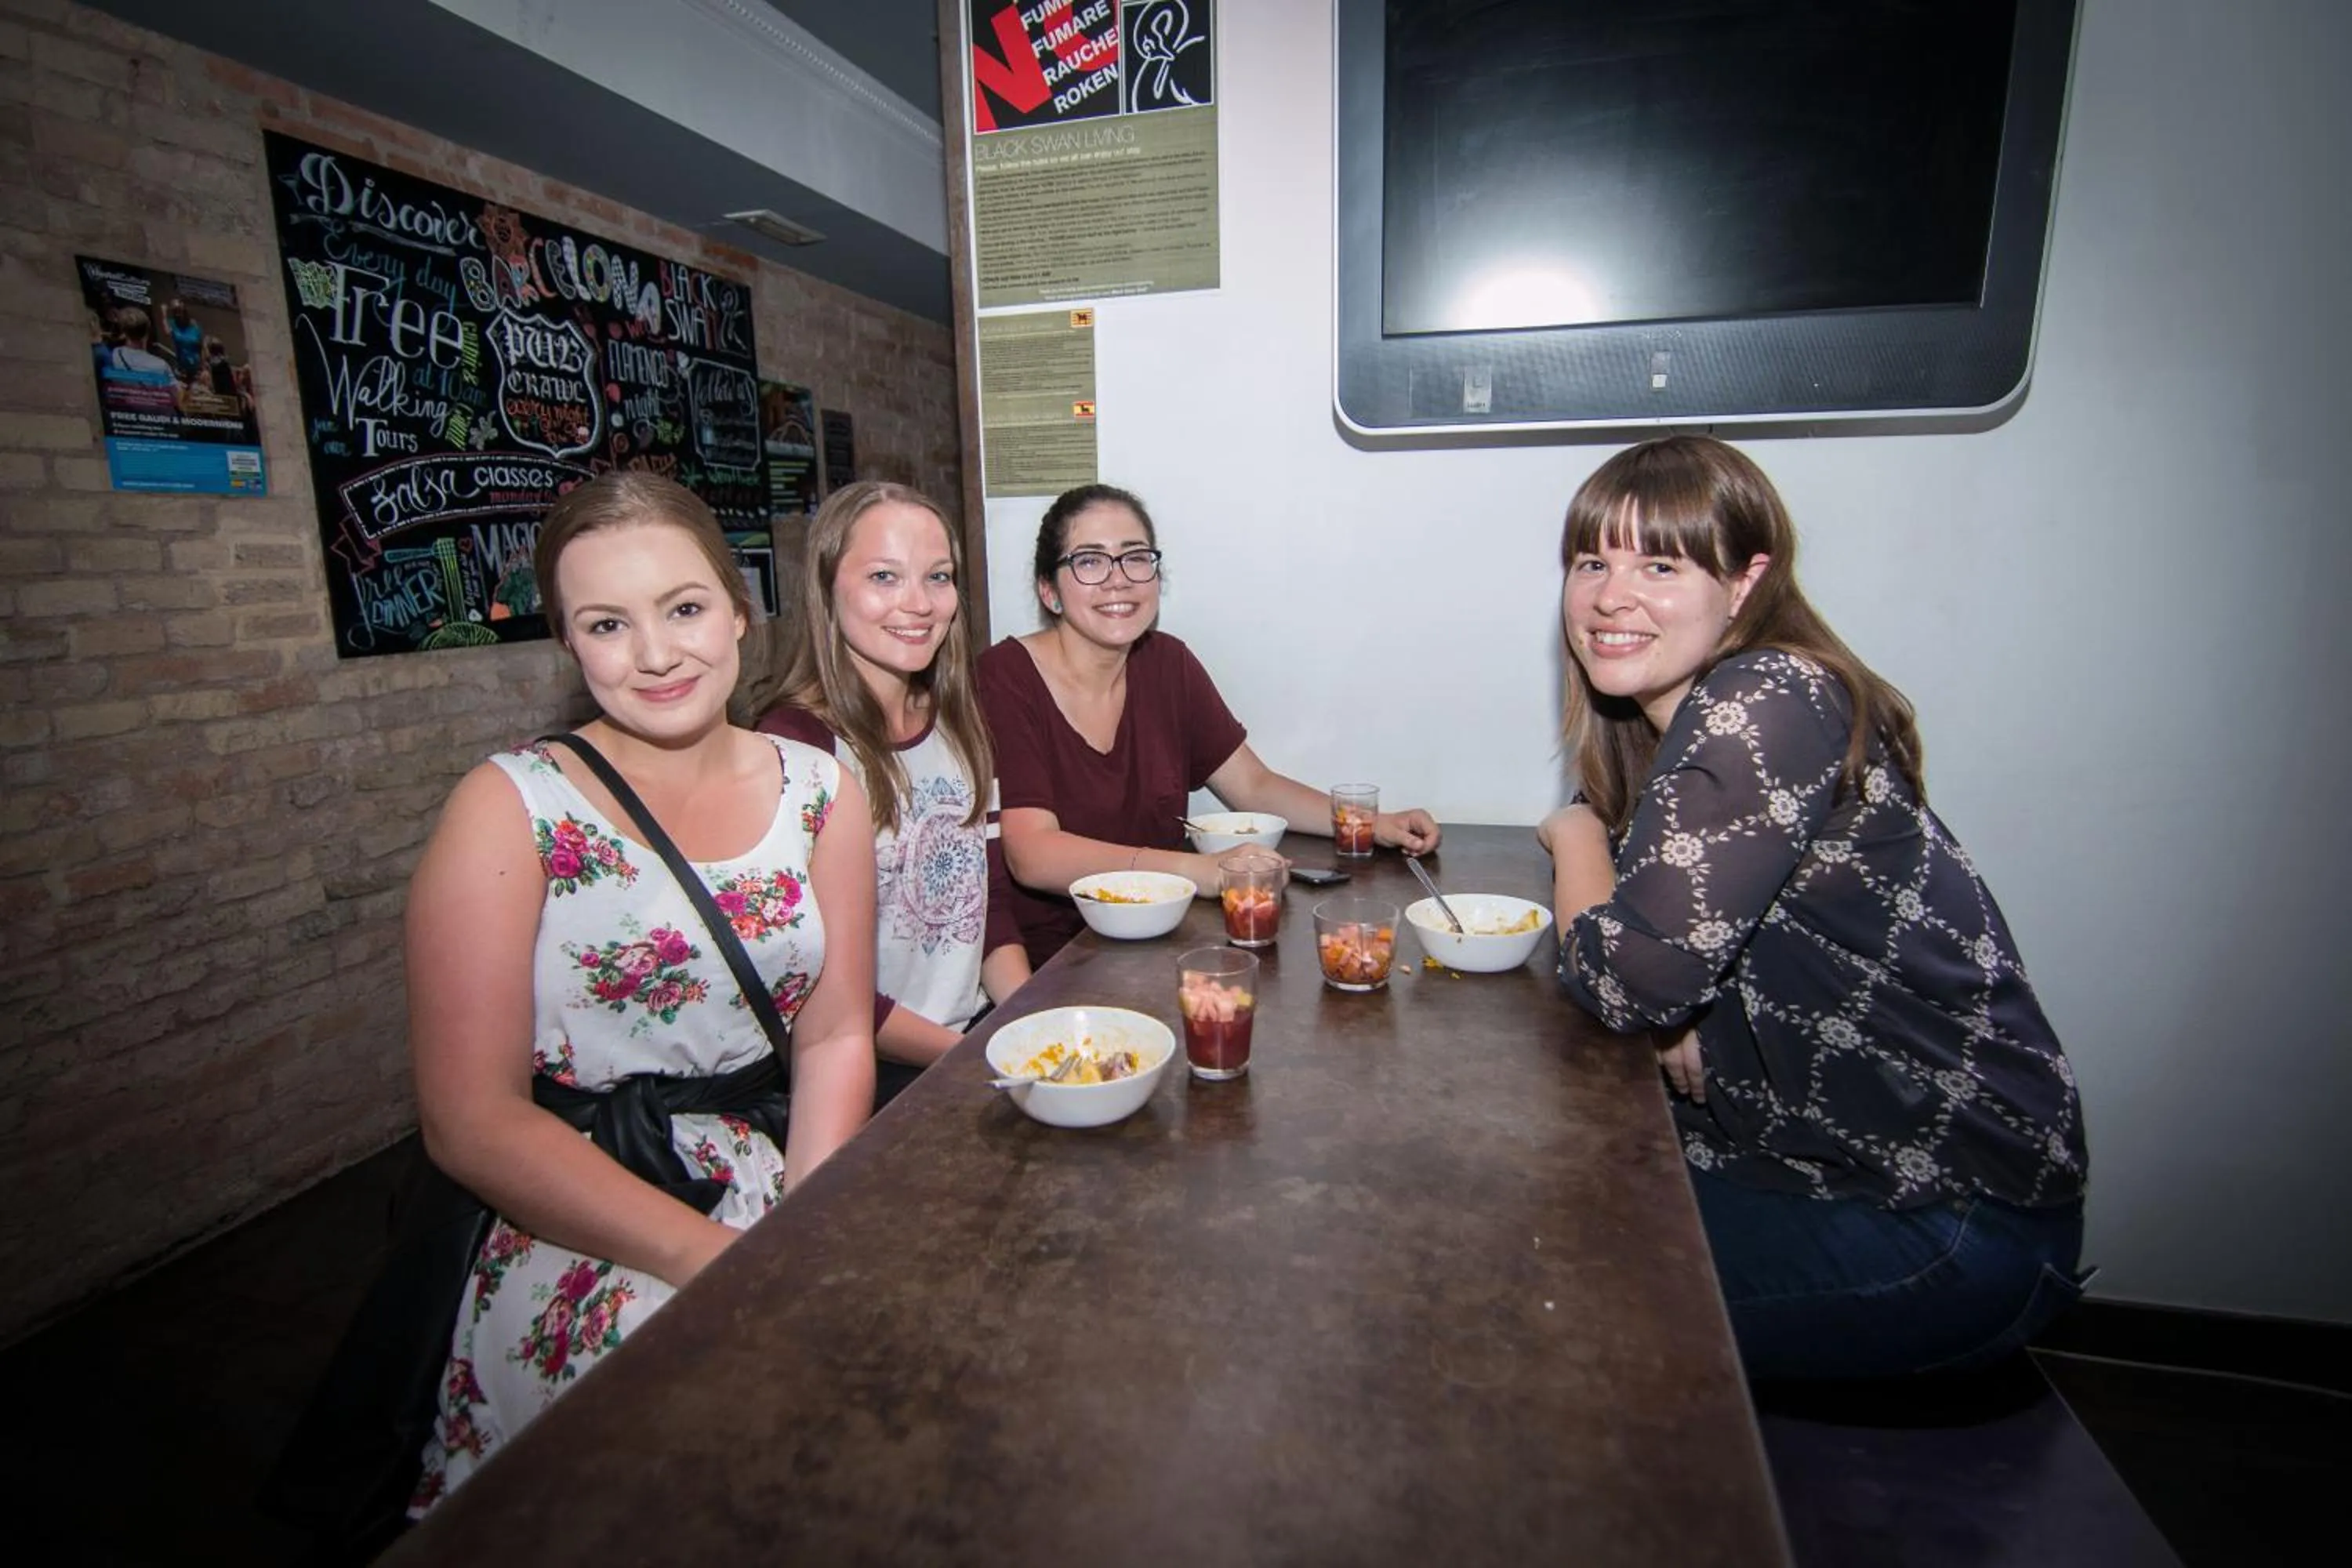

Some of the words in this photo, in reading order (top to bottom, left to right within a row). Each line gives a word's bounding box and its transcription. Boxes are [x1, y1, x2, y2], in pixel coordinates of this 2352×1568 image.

[1020, 0, 1073, 31] FUM
[1032, 2, 1111, 59] FUMARE
[1042, 24, 1120, 86] RAUCHE
[1053, 63, 1119, 114] ROKEN
[975, 139, 1027, 161] BLACK
[1030, 130, 1081, 154] SWAN
[1084, 124, 1134, 148] LIVING
[299, 152, 487, 250] Discover
[459, 235, 662, 336] BARCELONA
[658, 260, 717, 311] BLACK
[324, 260, 463, 368] Free
[665, 298, 720, 352] SWAN
[502, 314, 586, 373] PUB
[296, 312, 453, 439] Walking
[507, 370, 588, 403] CRAWL
[354, 417, 419, 457] Tours
